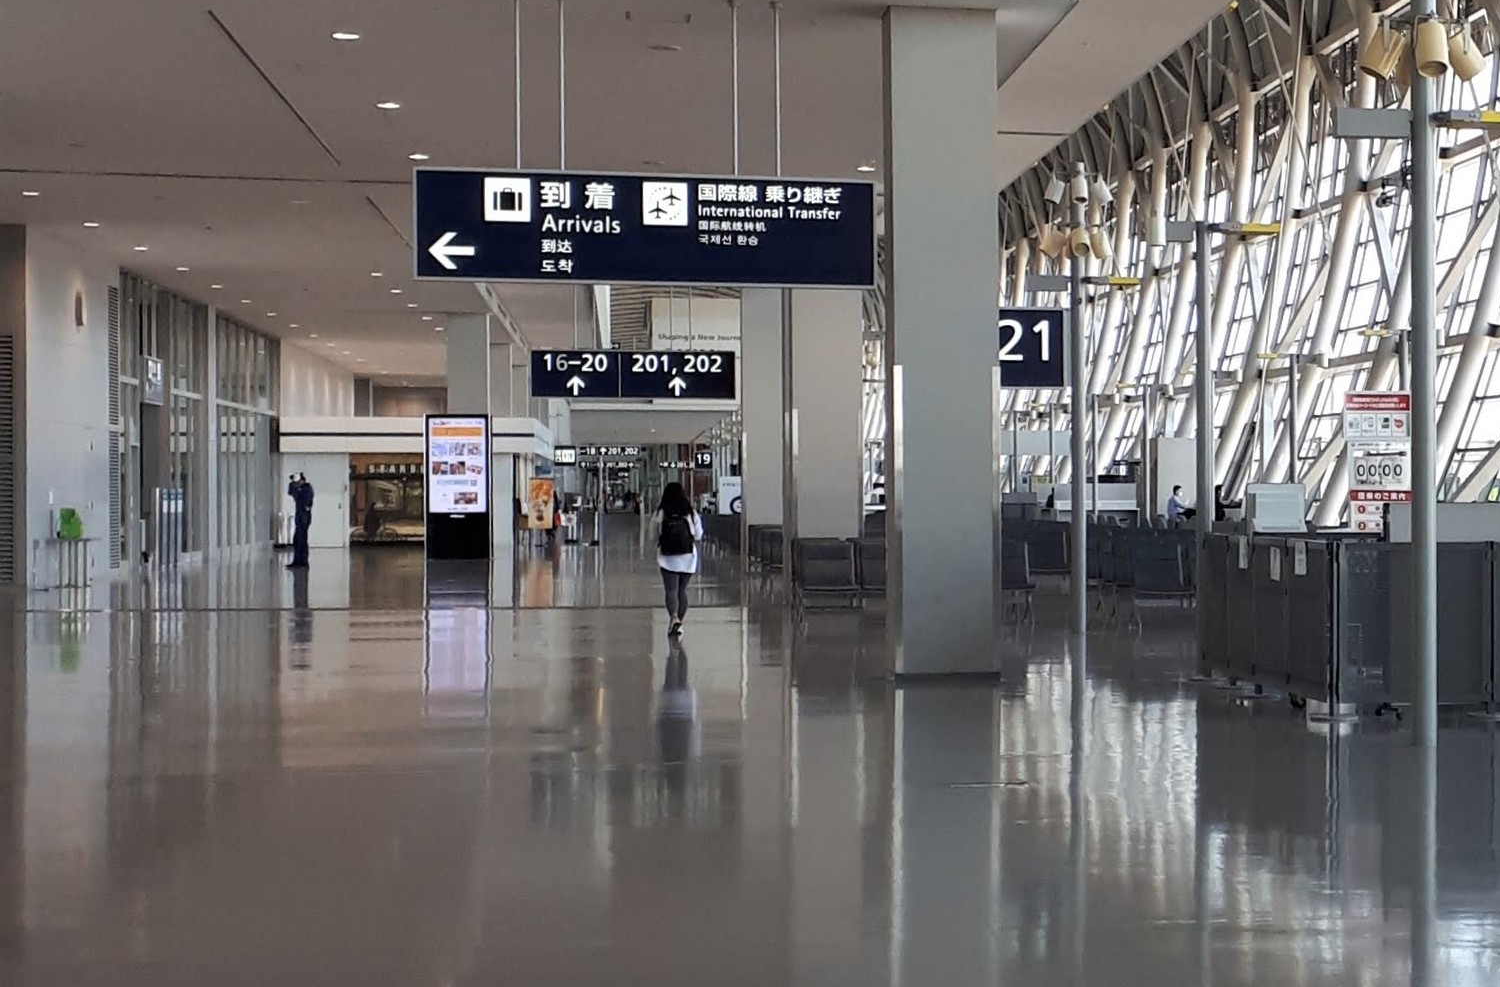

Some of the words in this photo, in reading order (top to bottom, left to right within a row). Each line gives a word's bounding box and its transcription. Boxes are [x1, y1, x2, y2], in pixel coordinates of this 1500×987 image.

[540, 181, 615, 210] 到着
[698, 184, 758, 202] 国際線
[765, 185, 842, 204] 乗り継ぎ
[698, 204, 783, 219] International
[787, 206, 842, 220] Transfer
[541, 213, 621, 234] Arrivals
[541, 239, 572, 253] 到达
[698, 234, 732, 245] 국제선
[736, 235, 759, 246] 환승
[540, 259, 573, 273] 도착
[998, 318, 1050, 361] 21
[697, 453, 711, 465] 19
[1356, 464, 1403, 477] 00:00
